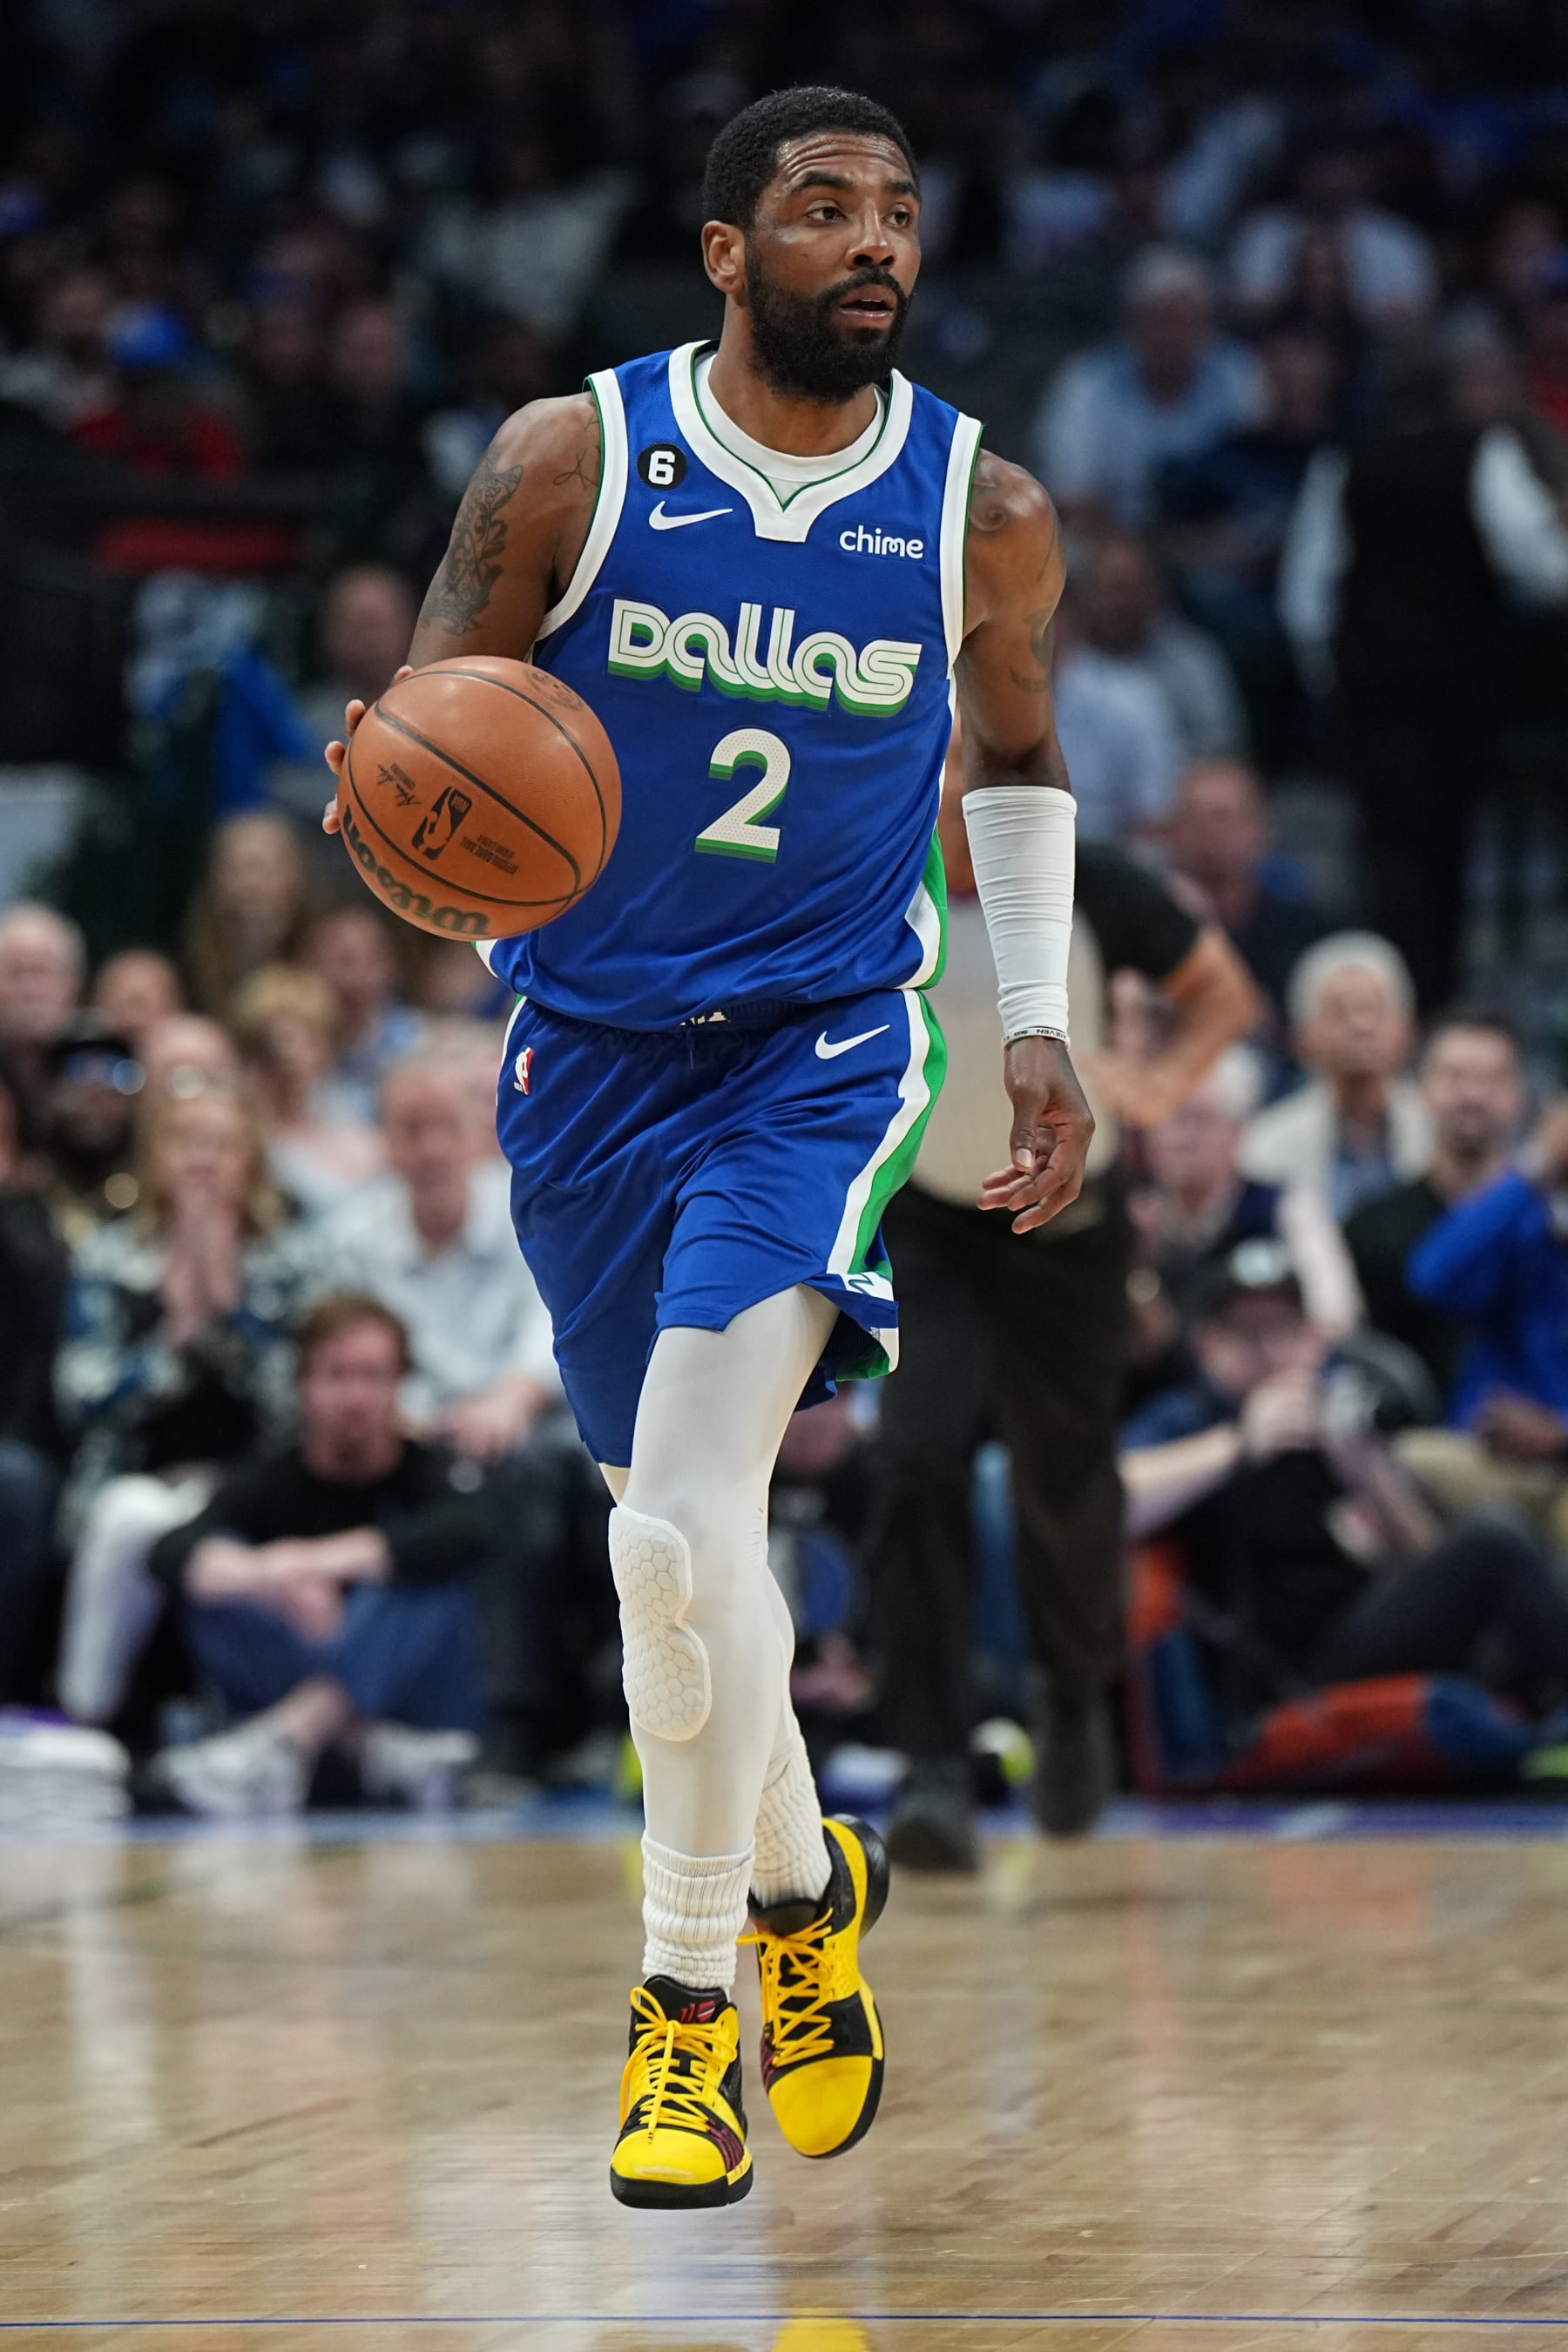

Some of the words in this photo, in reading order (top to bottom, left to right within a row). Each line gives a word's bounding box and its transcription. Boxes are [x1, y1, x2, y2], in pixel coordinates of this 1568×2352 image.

[647, 449, 675, 485] 6
[839, 525, 923, 559] chime
[607, 598, 923, 717] Dallas
[451, 794, 469, 814] NBA
[694, 727, 791, 863] 2
